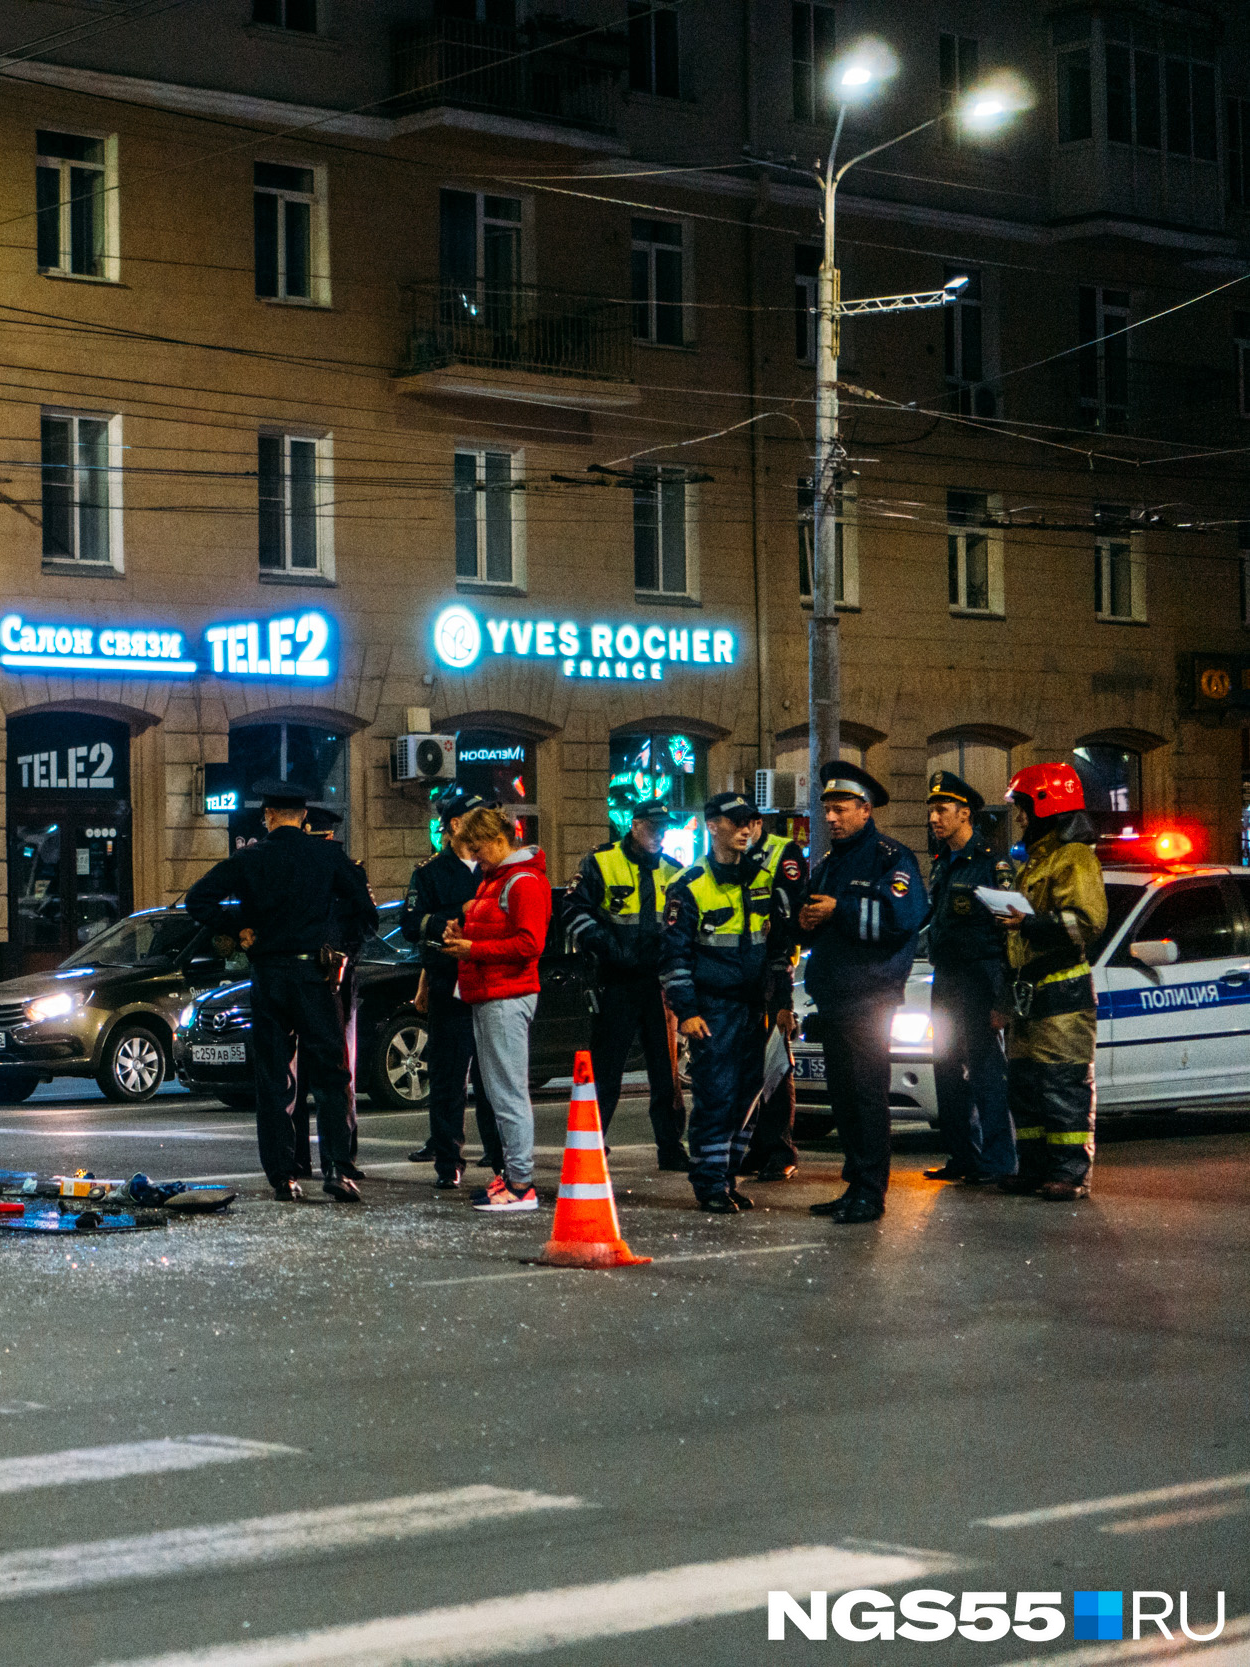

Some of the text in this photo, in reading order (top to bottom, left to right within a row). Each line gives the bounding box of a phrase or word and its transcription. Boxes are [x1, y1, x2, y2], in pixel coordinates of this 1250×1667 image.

[0, 614, 182, 658] Салон связи
[206, 612, 330, 677] TELE2
[486, 618, 734, 664] YVES ROCHER
[563, 659, 662, 680] FRANCE
[17, 742, 115, 789] TELE2
[206, 792, 236, 811] TELE2
[1140, 984, 1220, 1010] ПОЛИЦИЯ
